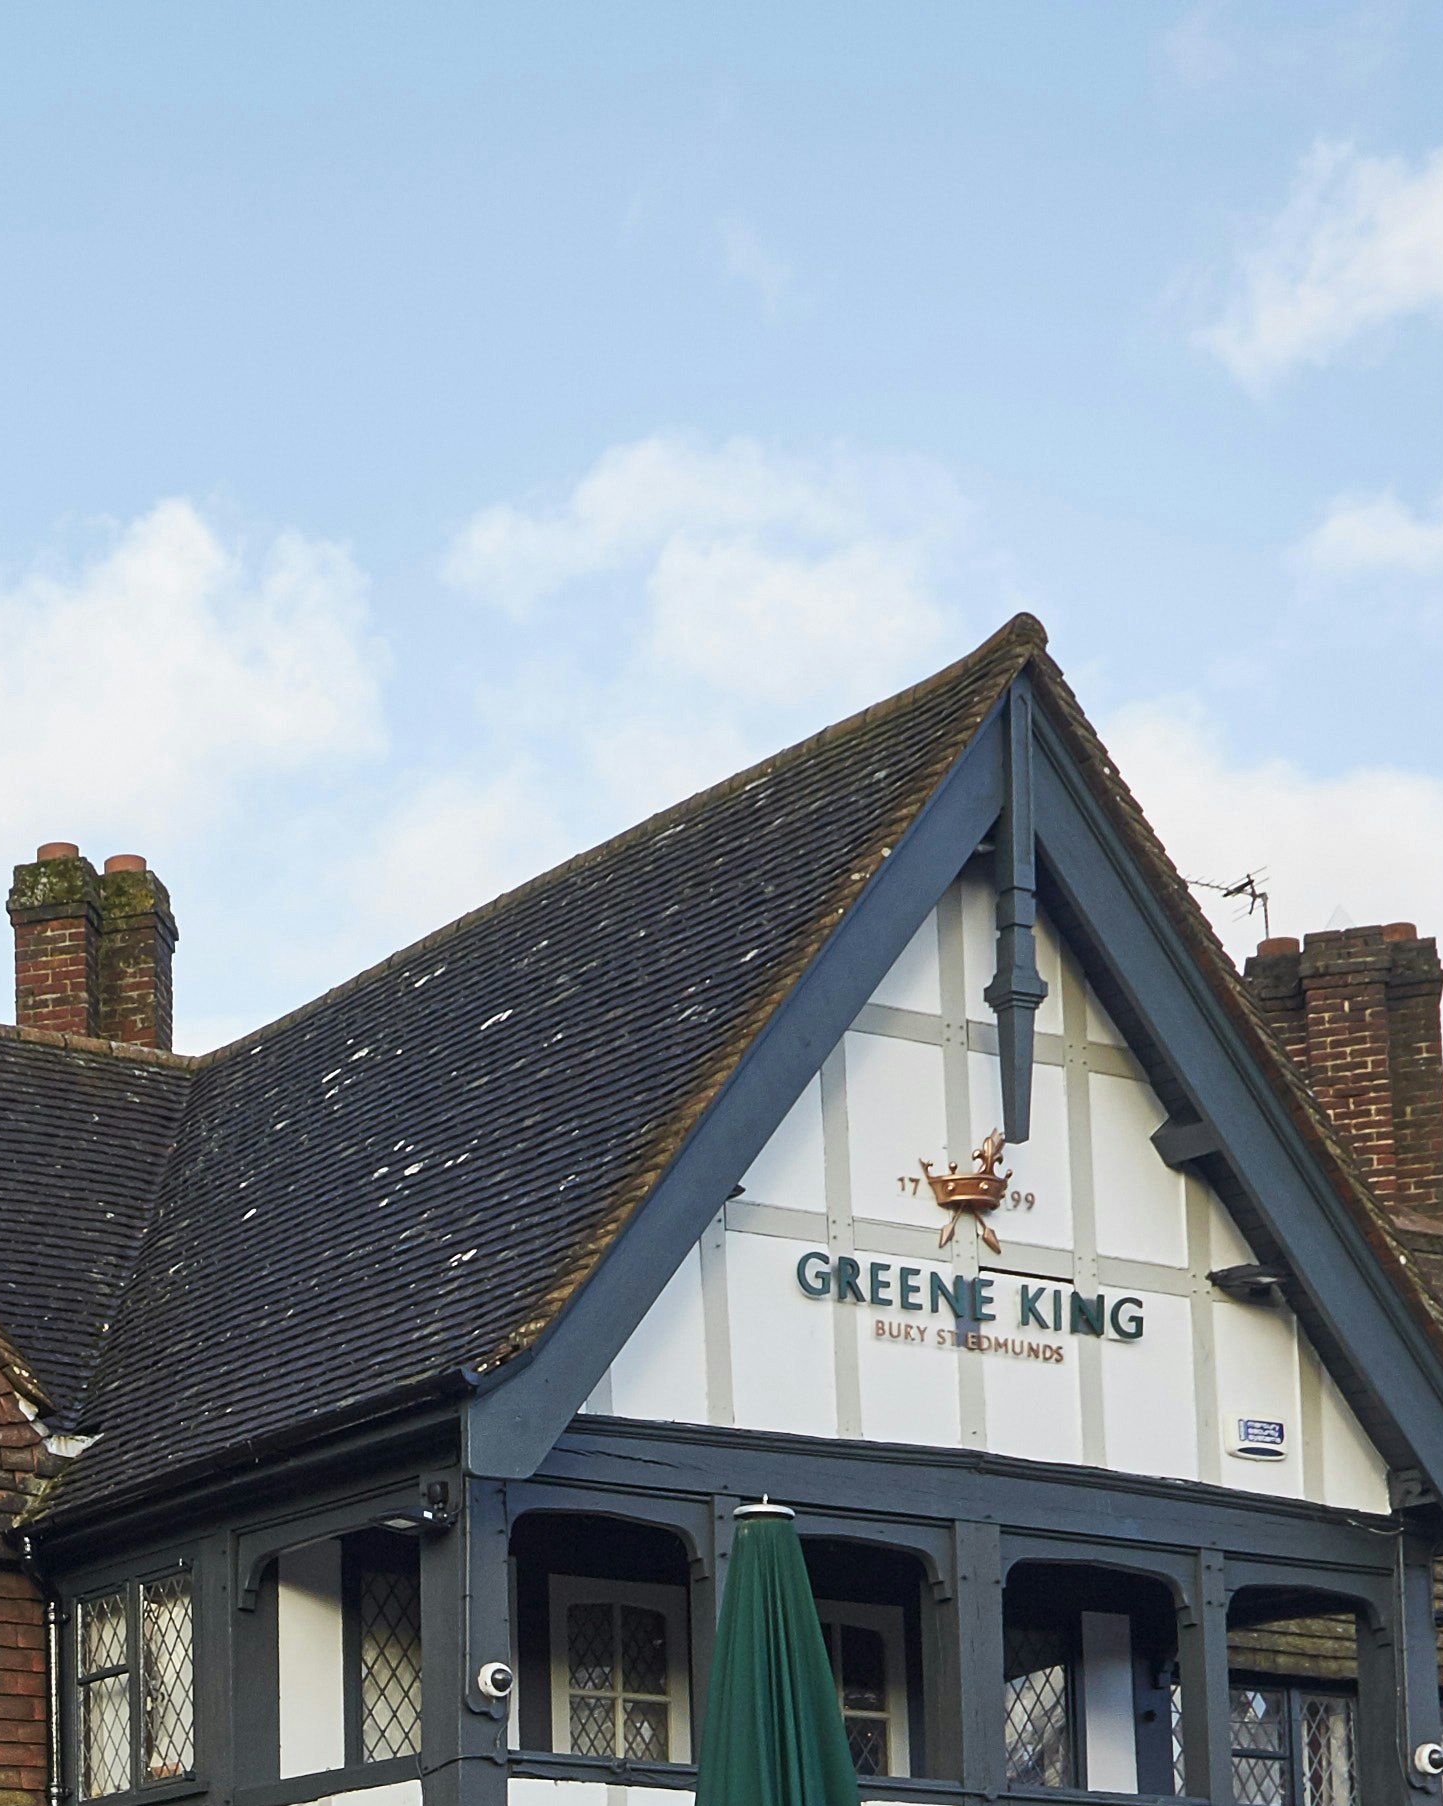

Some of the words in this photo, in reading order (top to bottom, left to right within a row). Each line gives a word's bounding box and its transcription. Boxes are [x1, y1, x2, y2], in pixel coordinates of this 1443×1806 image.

[897, 1176, 920, 1196] 17
[1011, 1190, 1035, 1210] 99
[797, 1251, 996, 1321] GREENE
[1020, 1284, 1144, 1339] KING
[875, 1319, 928, 1342] BURY
[936, 1328, 958, 1346] ST
[966, 1332, 1064, 1363] EDMUNDS
